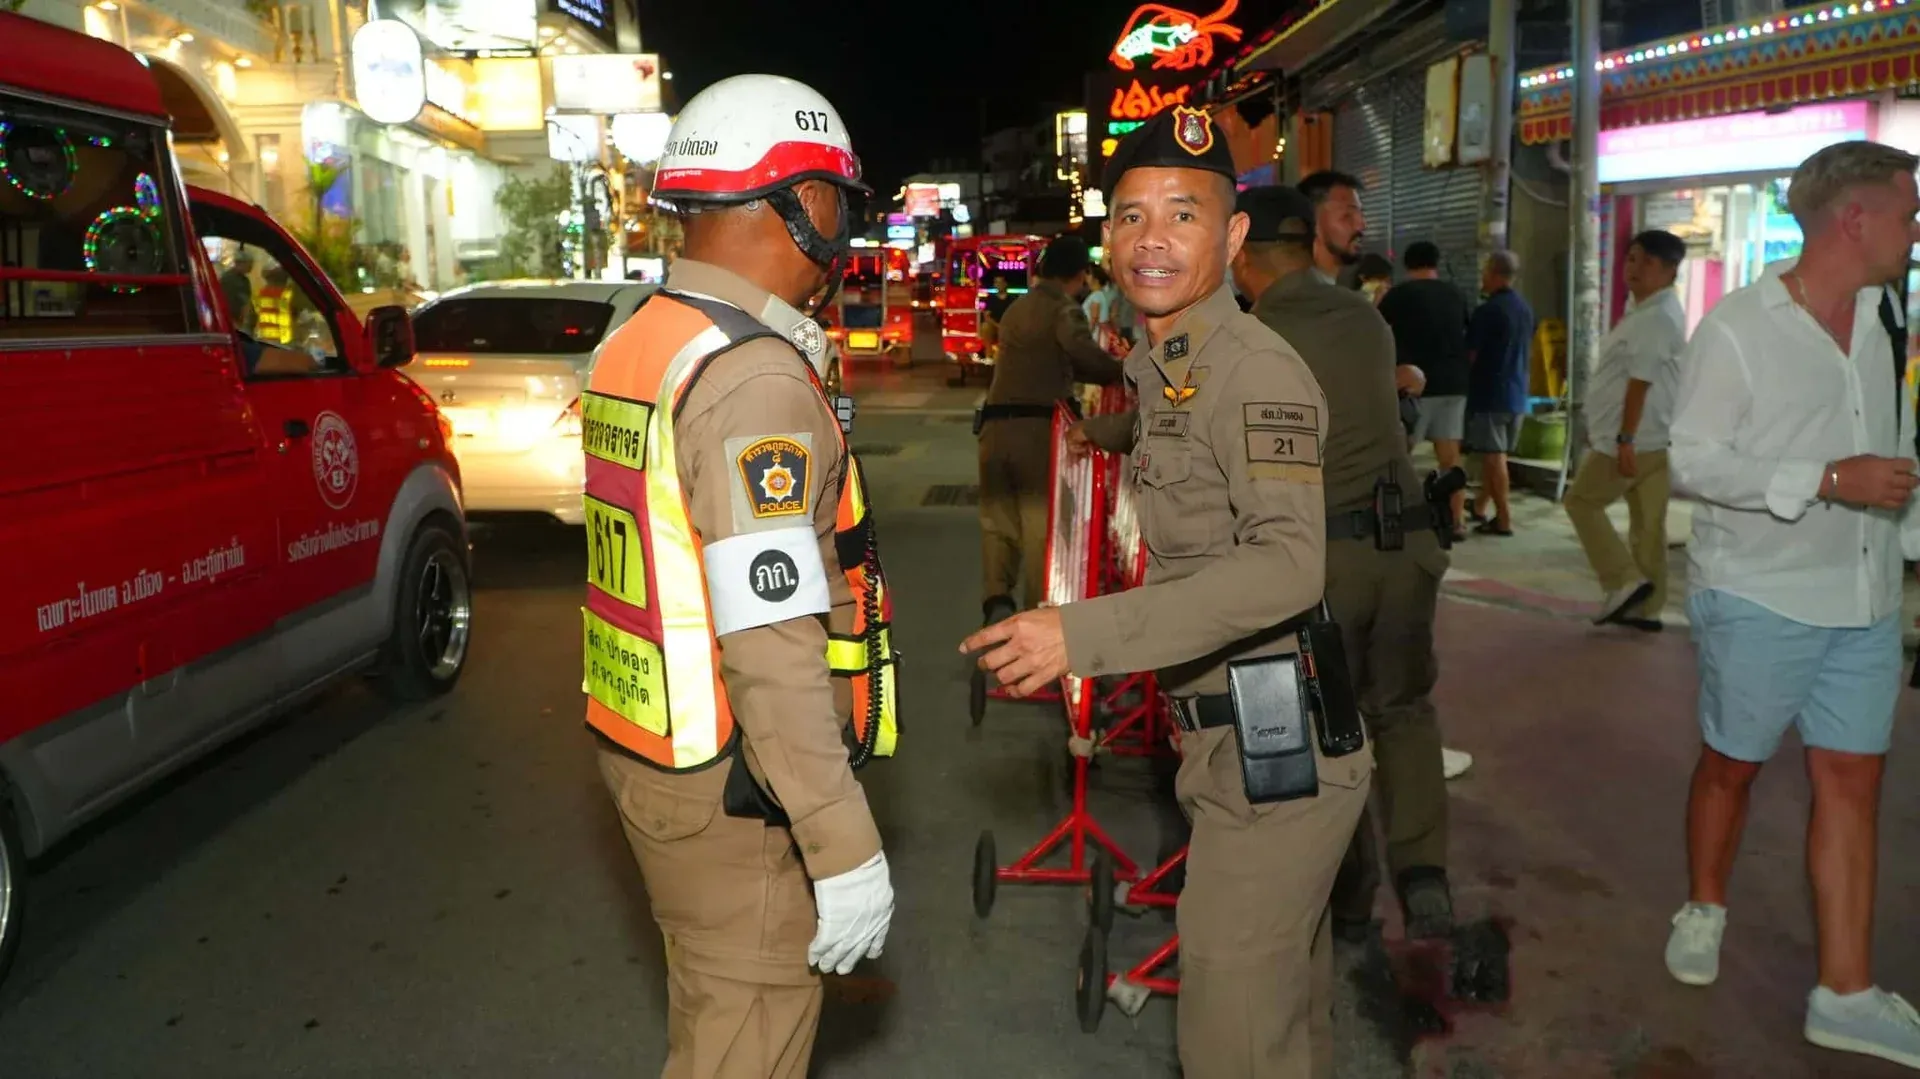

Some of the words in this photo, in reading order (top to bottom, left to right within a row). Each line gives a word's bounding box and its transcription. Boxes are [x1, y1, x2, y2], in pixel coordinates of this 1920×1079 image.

[795, 110, 829, 134] 617
[1273, 438, 1295, 456] 21
[760, 500, 801, 513] POLICE
[593, 511, 628, 594] 617
[756, 563, 797, 594] ภก.
[607, 634, 650, 676] ป่าตอง
